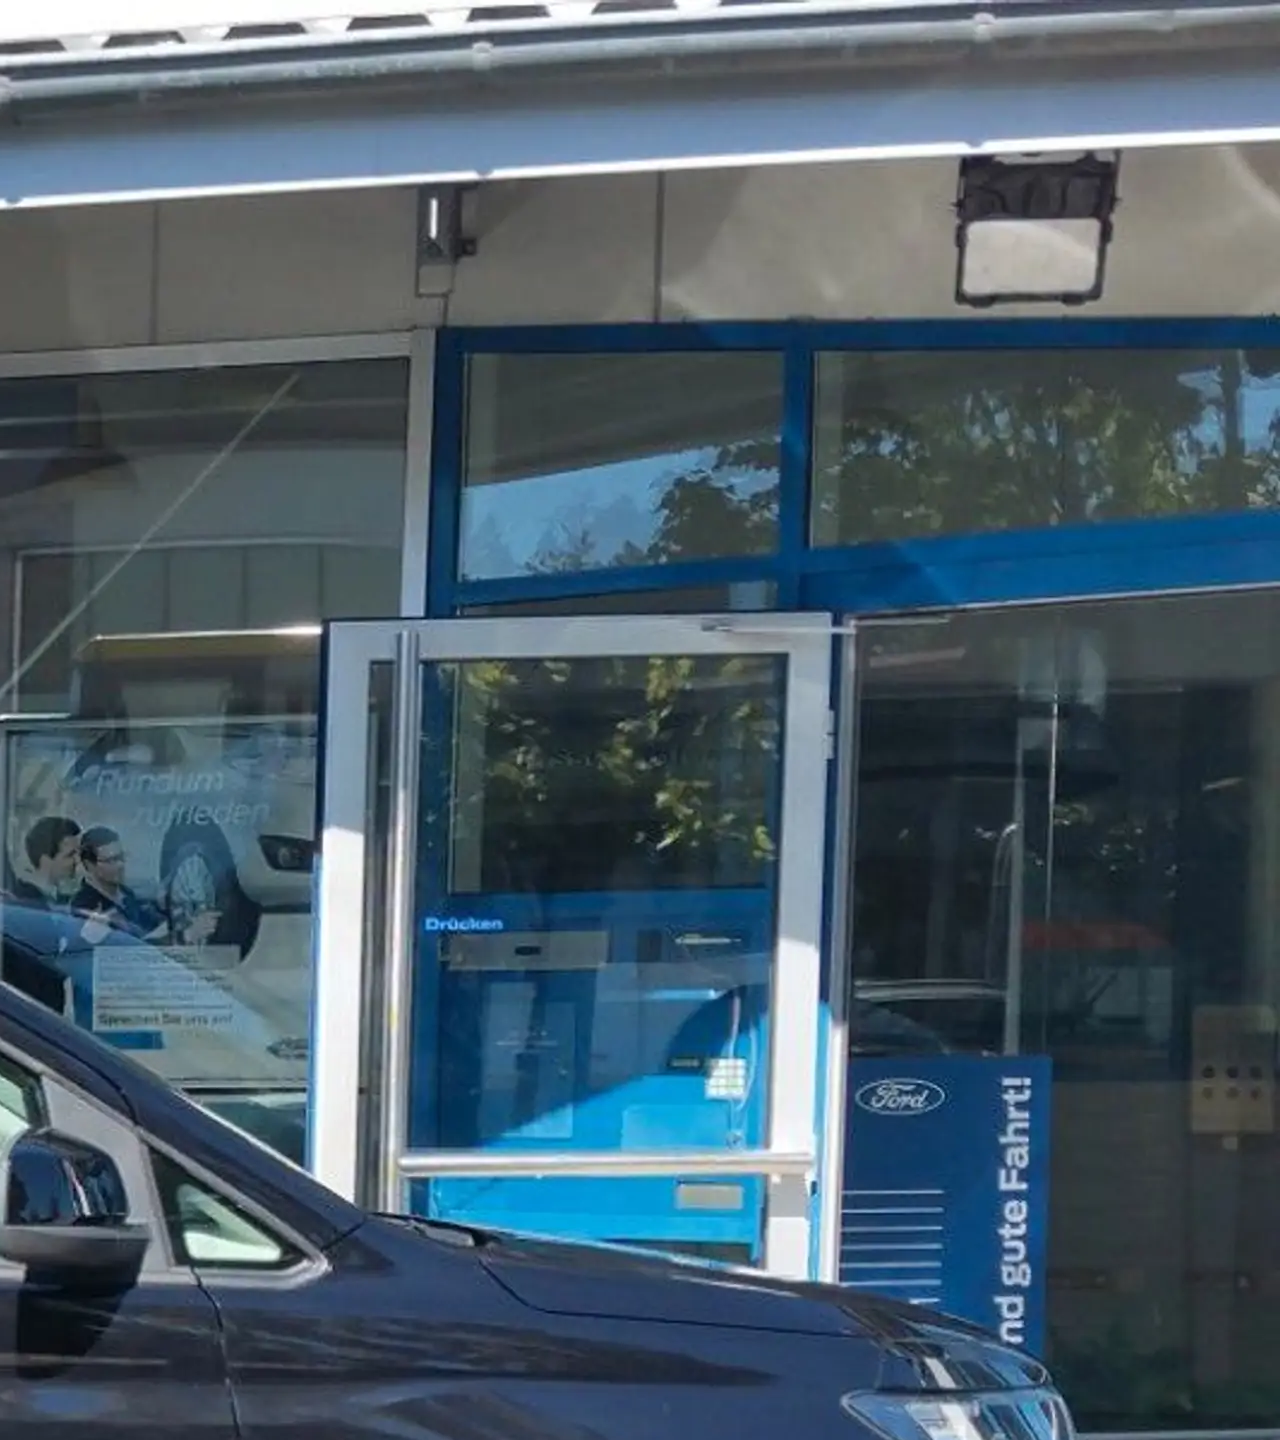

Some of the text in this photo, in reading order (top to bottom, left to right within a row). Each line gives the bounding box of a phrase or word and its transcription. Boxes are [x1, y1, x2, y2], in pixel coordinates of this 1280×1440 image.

[425, 915, 504, 931] Drücken
[870, 1082, 929, 1109] Ford
[993, 1076, 1033, 1345] nd gute Fahrt!
